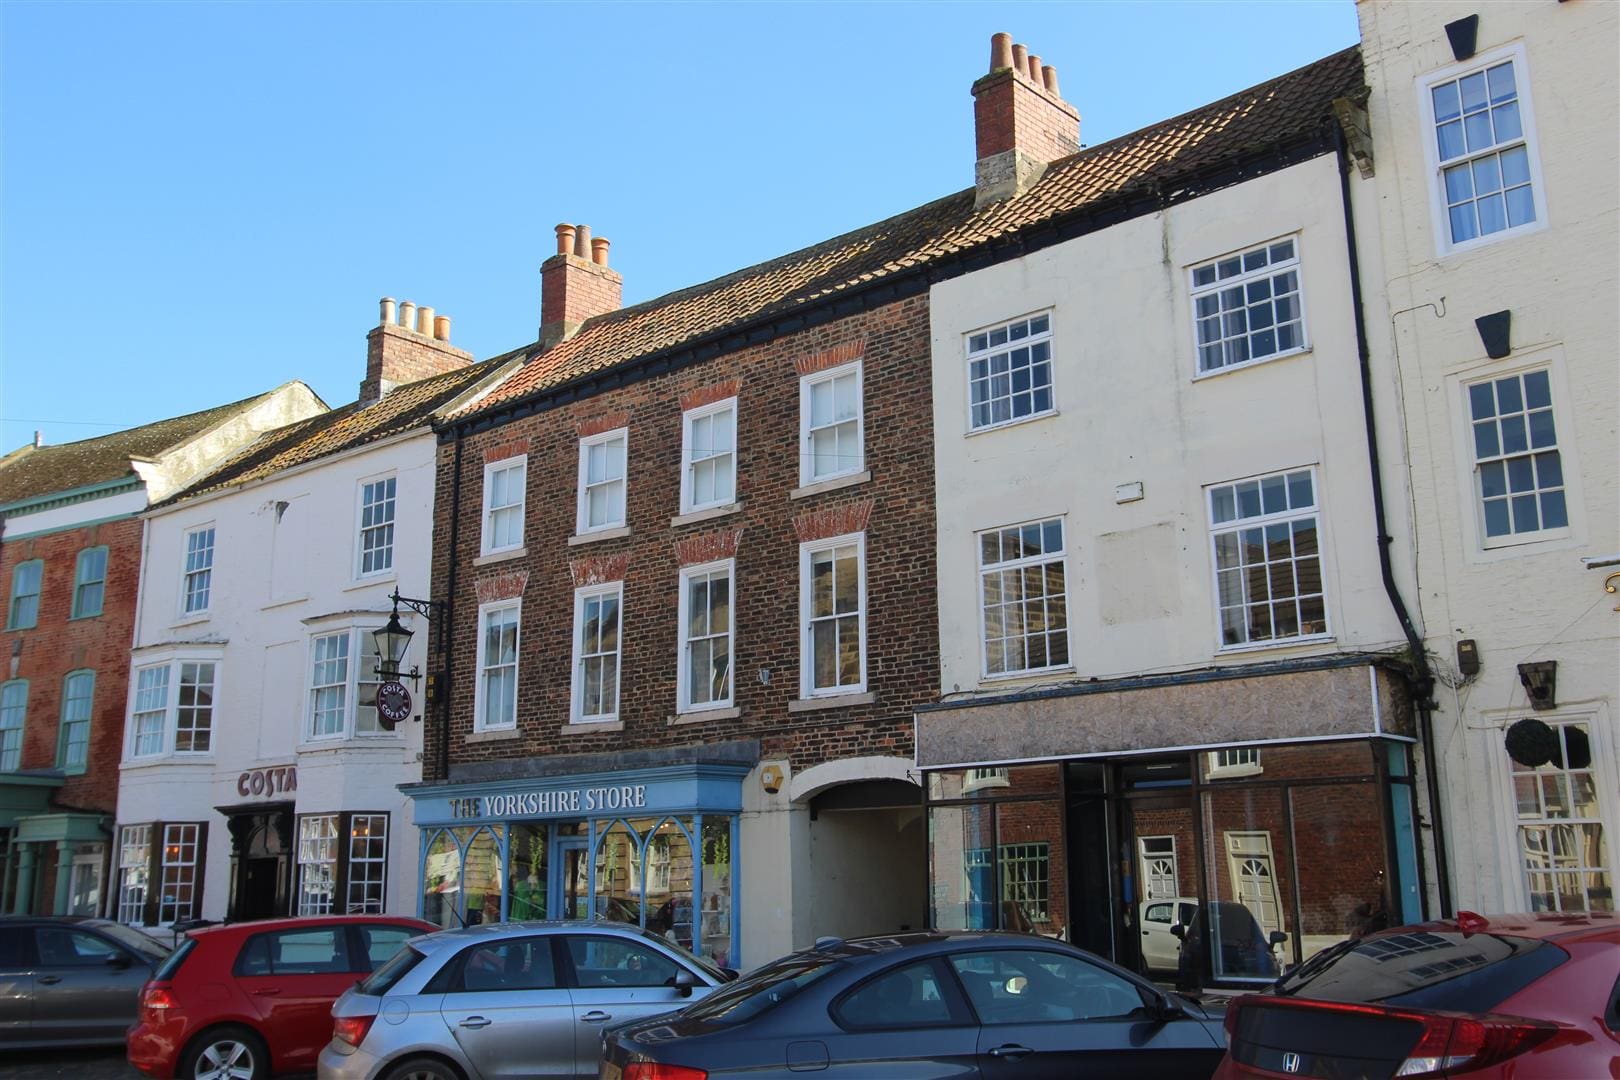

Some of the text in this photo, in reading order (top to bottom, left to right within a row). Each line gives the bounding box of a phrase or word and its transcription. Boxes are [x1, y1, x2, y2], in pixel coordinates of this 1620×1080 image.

[382, 686, 404, 697] COSTA
[382, 704, 408, 718] COFFEE
[238, 767, 298, 798] COSTA
[450, 785, 646, 818] THE YORKSHIRE STORE
